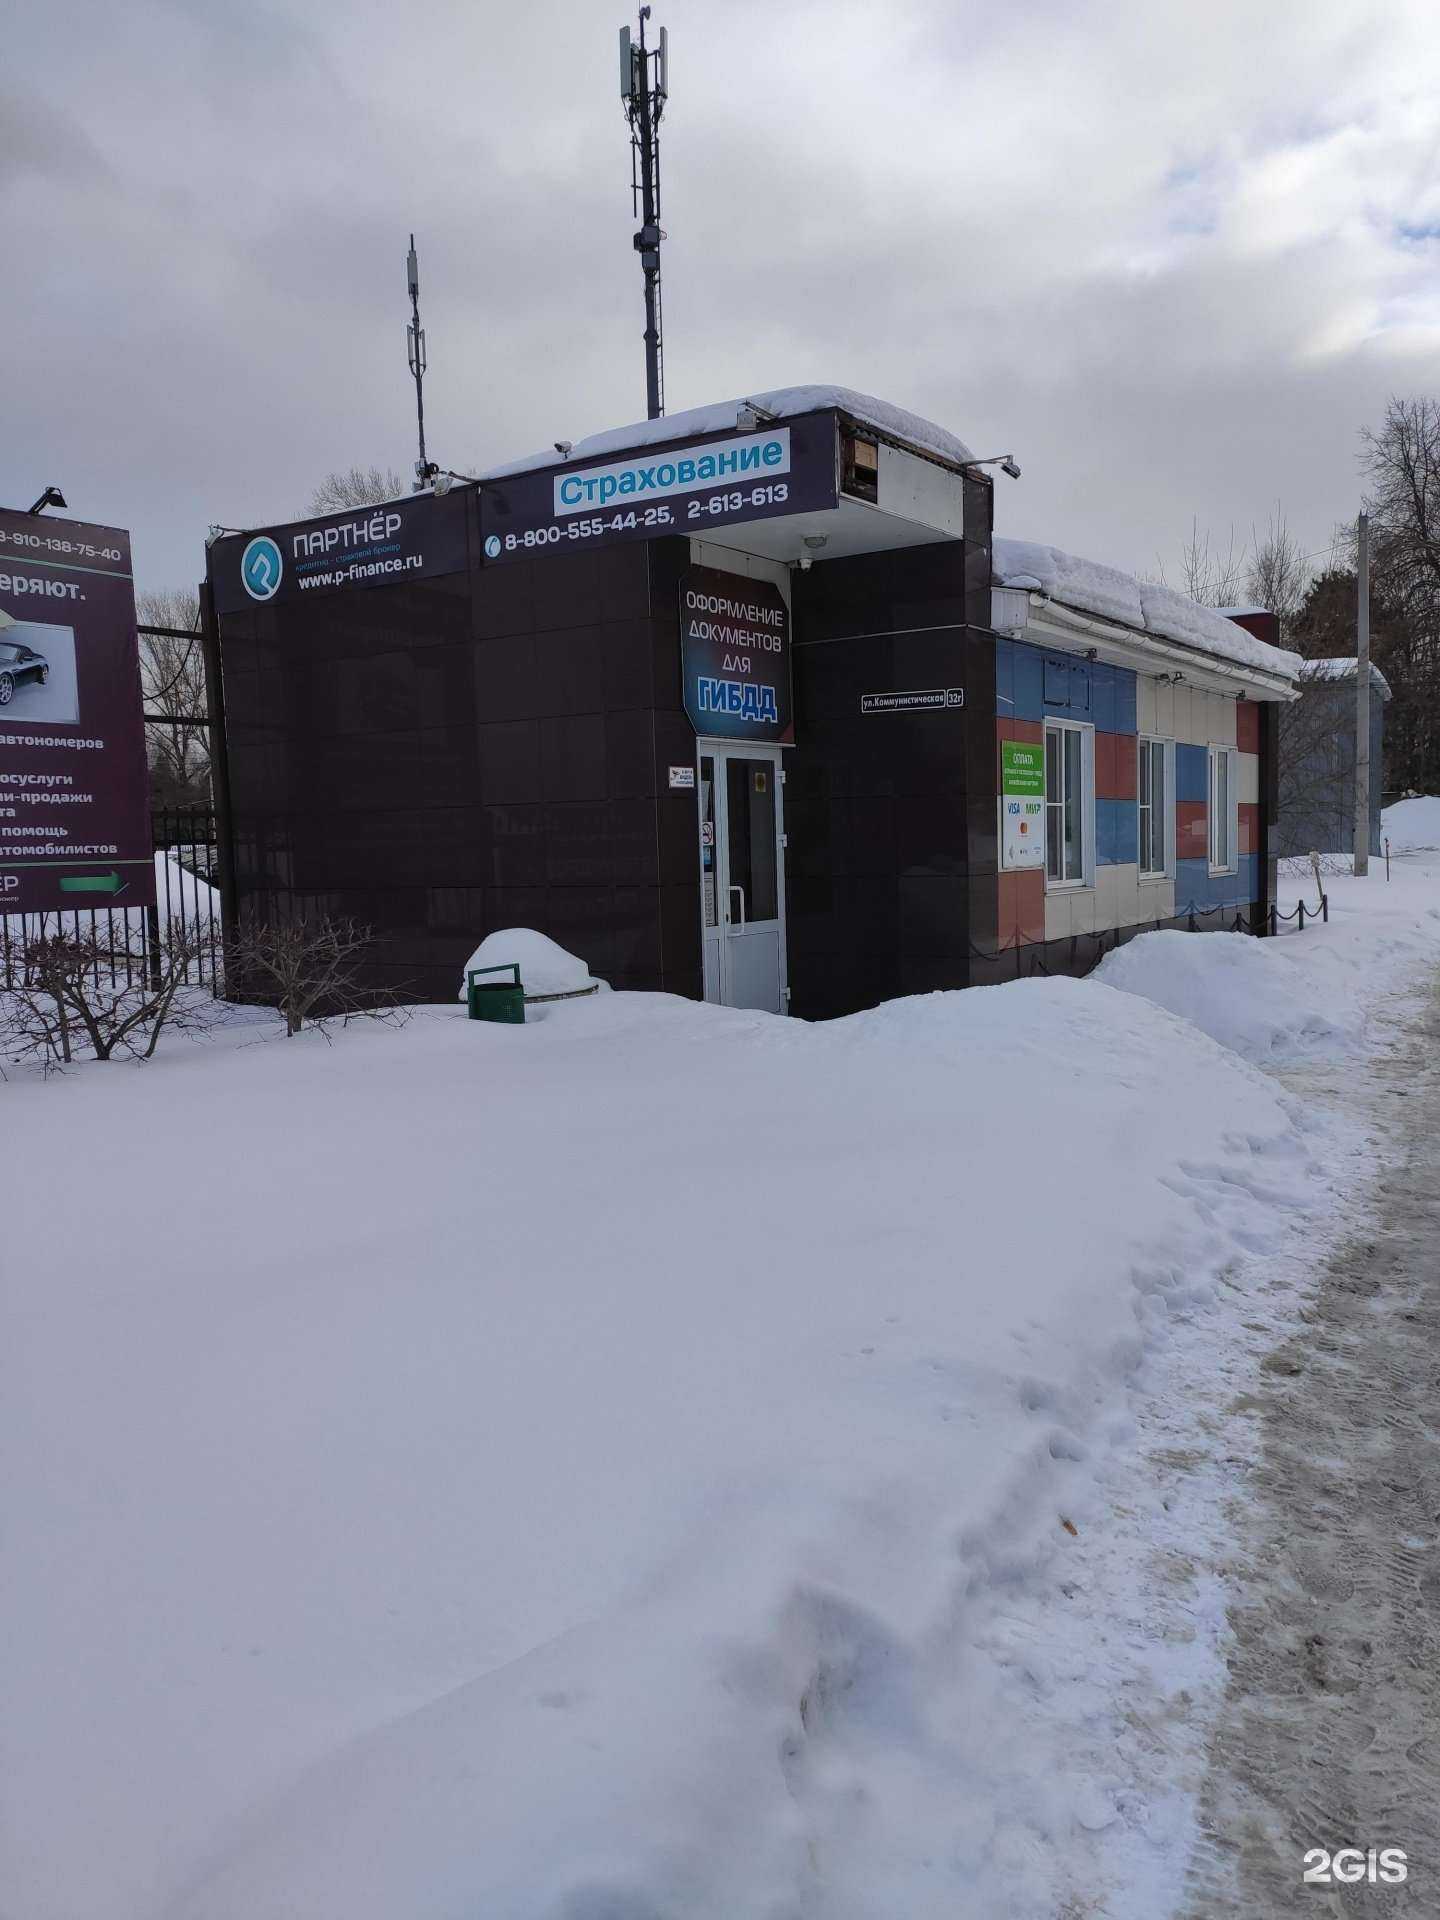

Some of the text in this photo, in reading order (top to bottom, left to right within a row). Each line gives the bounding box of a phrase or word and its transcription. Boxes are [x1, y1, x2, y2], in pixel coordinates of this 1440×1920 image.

[560, 441, 783, 504] Страхование
[293, 511, 401, 558] ПАРТНЁР
[505, 483, 789, 550] 8-800-555-44-25, 2-613-613
[298, 553, 423, 589] www.p-finance.ru
[686, 590, 783, 627] ОФОРМЛЕНИЕ
[688, 620, 782, 652] ДОКУМЕНТОВ
[722, 653, 751, 673] ДЛЯ
[698, 676, 778, 723] ГИБДД
[1008, 802, 1020, 814] VISA
[2, 826, 68, 838] помощь
